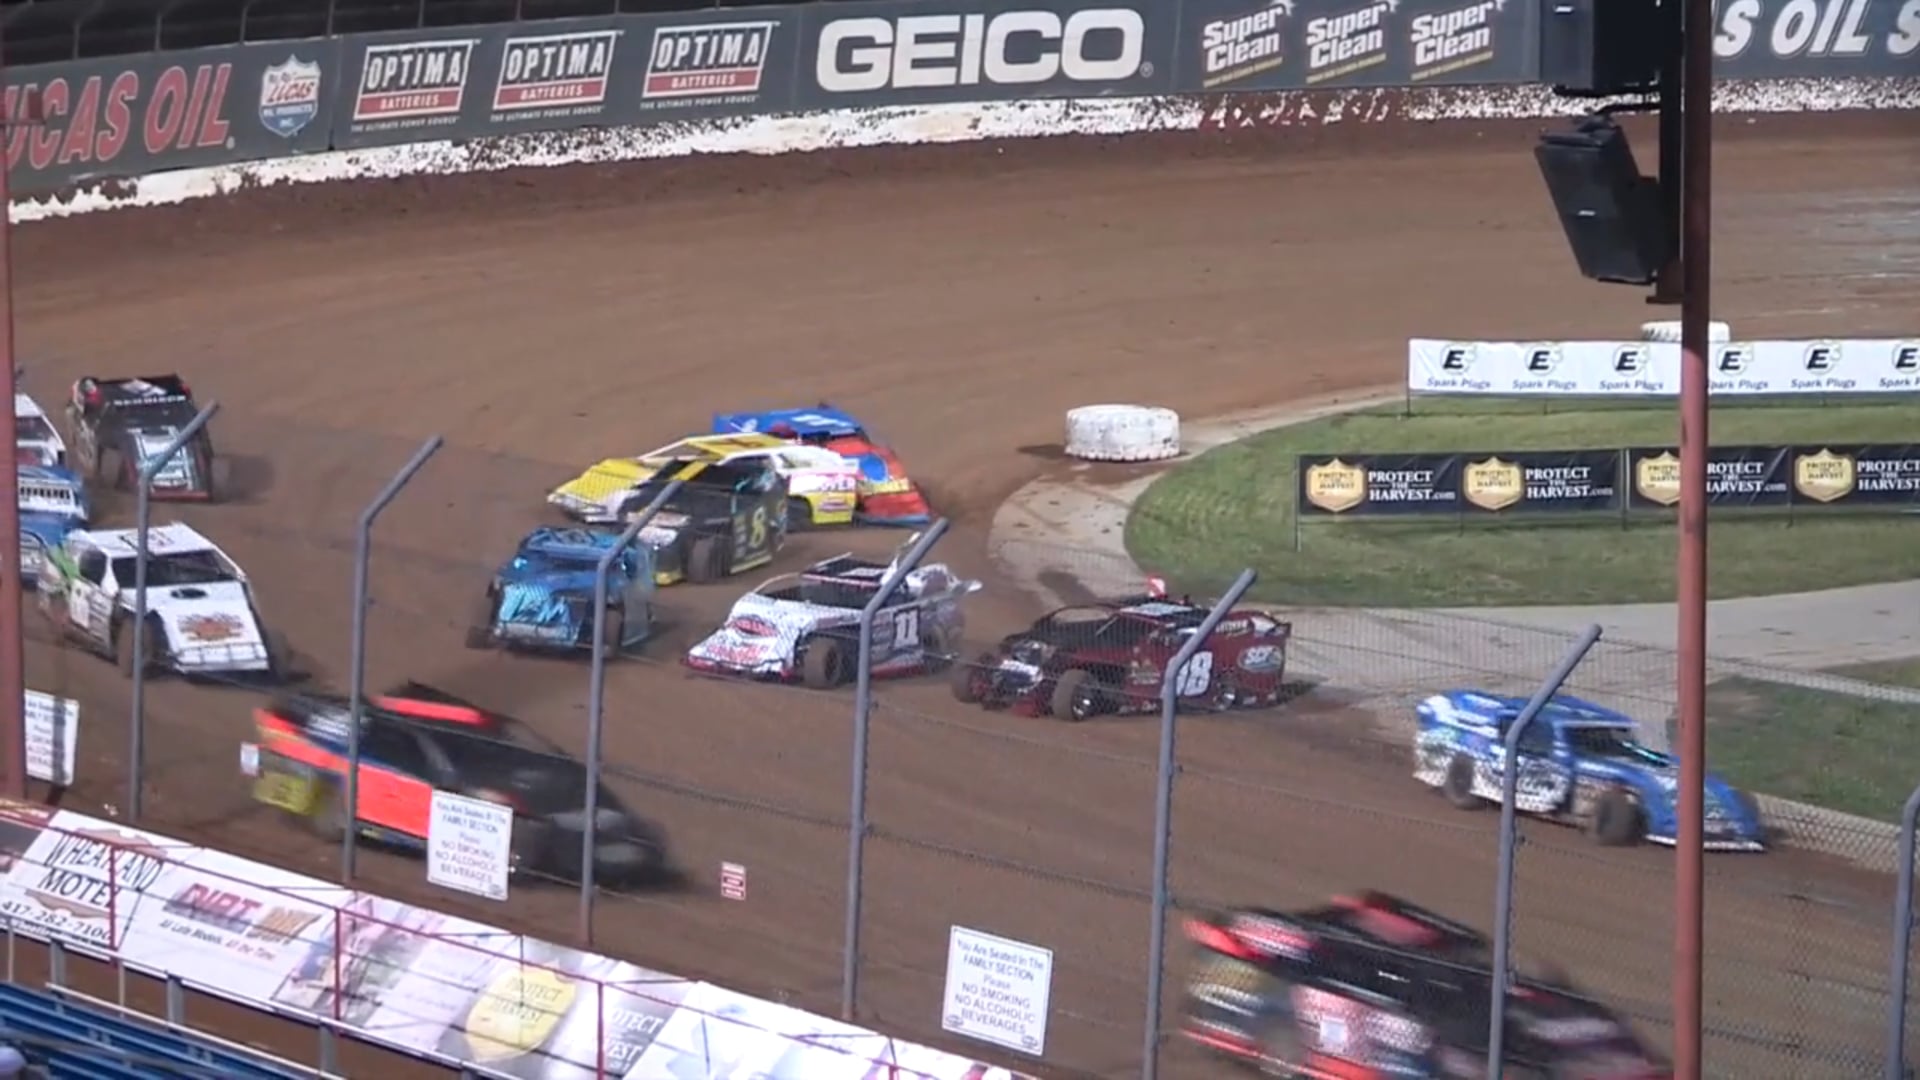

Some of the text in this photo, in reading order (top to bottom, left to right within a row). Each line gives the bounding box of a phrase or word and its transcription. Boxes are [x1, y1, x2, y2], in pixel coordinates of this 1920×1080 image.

[1203, 6, 1283, 49] Super
[1306, 3, 1387, 45] Super
[1411, 2, 1494, 42] Super
[1771, 0, 1870, 56] OIL
[507, 42, 605, 80] OPTIMA
[656, 33, 760, 68] OPTIMA
[816, 9, 1145, 92] GEICO
[1207, 33, 1280, 72] Clean
[1310, 30, 1383, 68] Clean
[1415, 27, 1490, 66] Clean
[367, 51, 461, 89] OPTIMA
[671, 74, 736, 88] BATTERIES
[380, 94, 439, 110] BATTERIES
[520, 84, 583, 100] BATTERIES
[144, 63, 232, 153] OIL
[1709, 381, 1734, 391] park
[1368, 470, 1433, 482] PROTECT
[1525, 467, 1591, 480] PROTECT
[1707, 462, 1764, 474] ROTECT
[1706, 481, 1787, 493] ARVEST.com
[964, 954, 1034, 981] FAMILY SECTION
[955, 994, 971, 1006] NO
[973, 999, 1035, 1024] ALCOHOLIC
[962, 982, 1030, 1009] NO SMOKING
[612, 1007, 665, 1035] OTECT
[961, 1008, 1026, 1034] BEVERAGES
